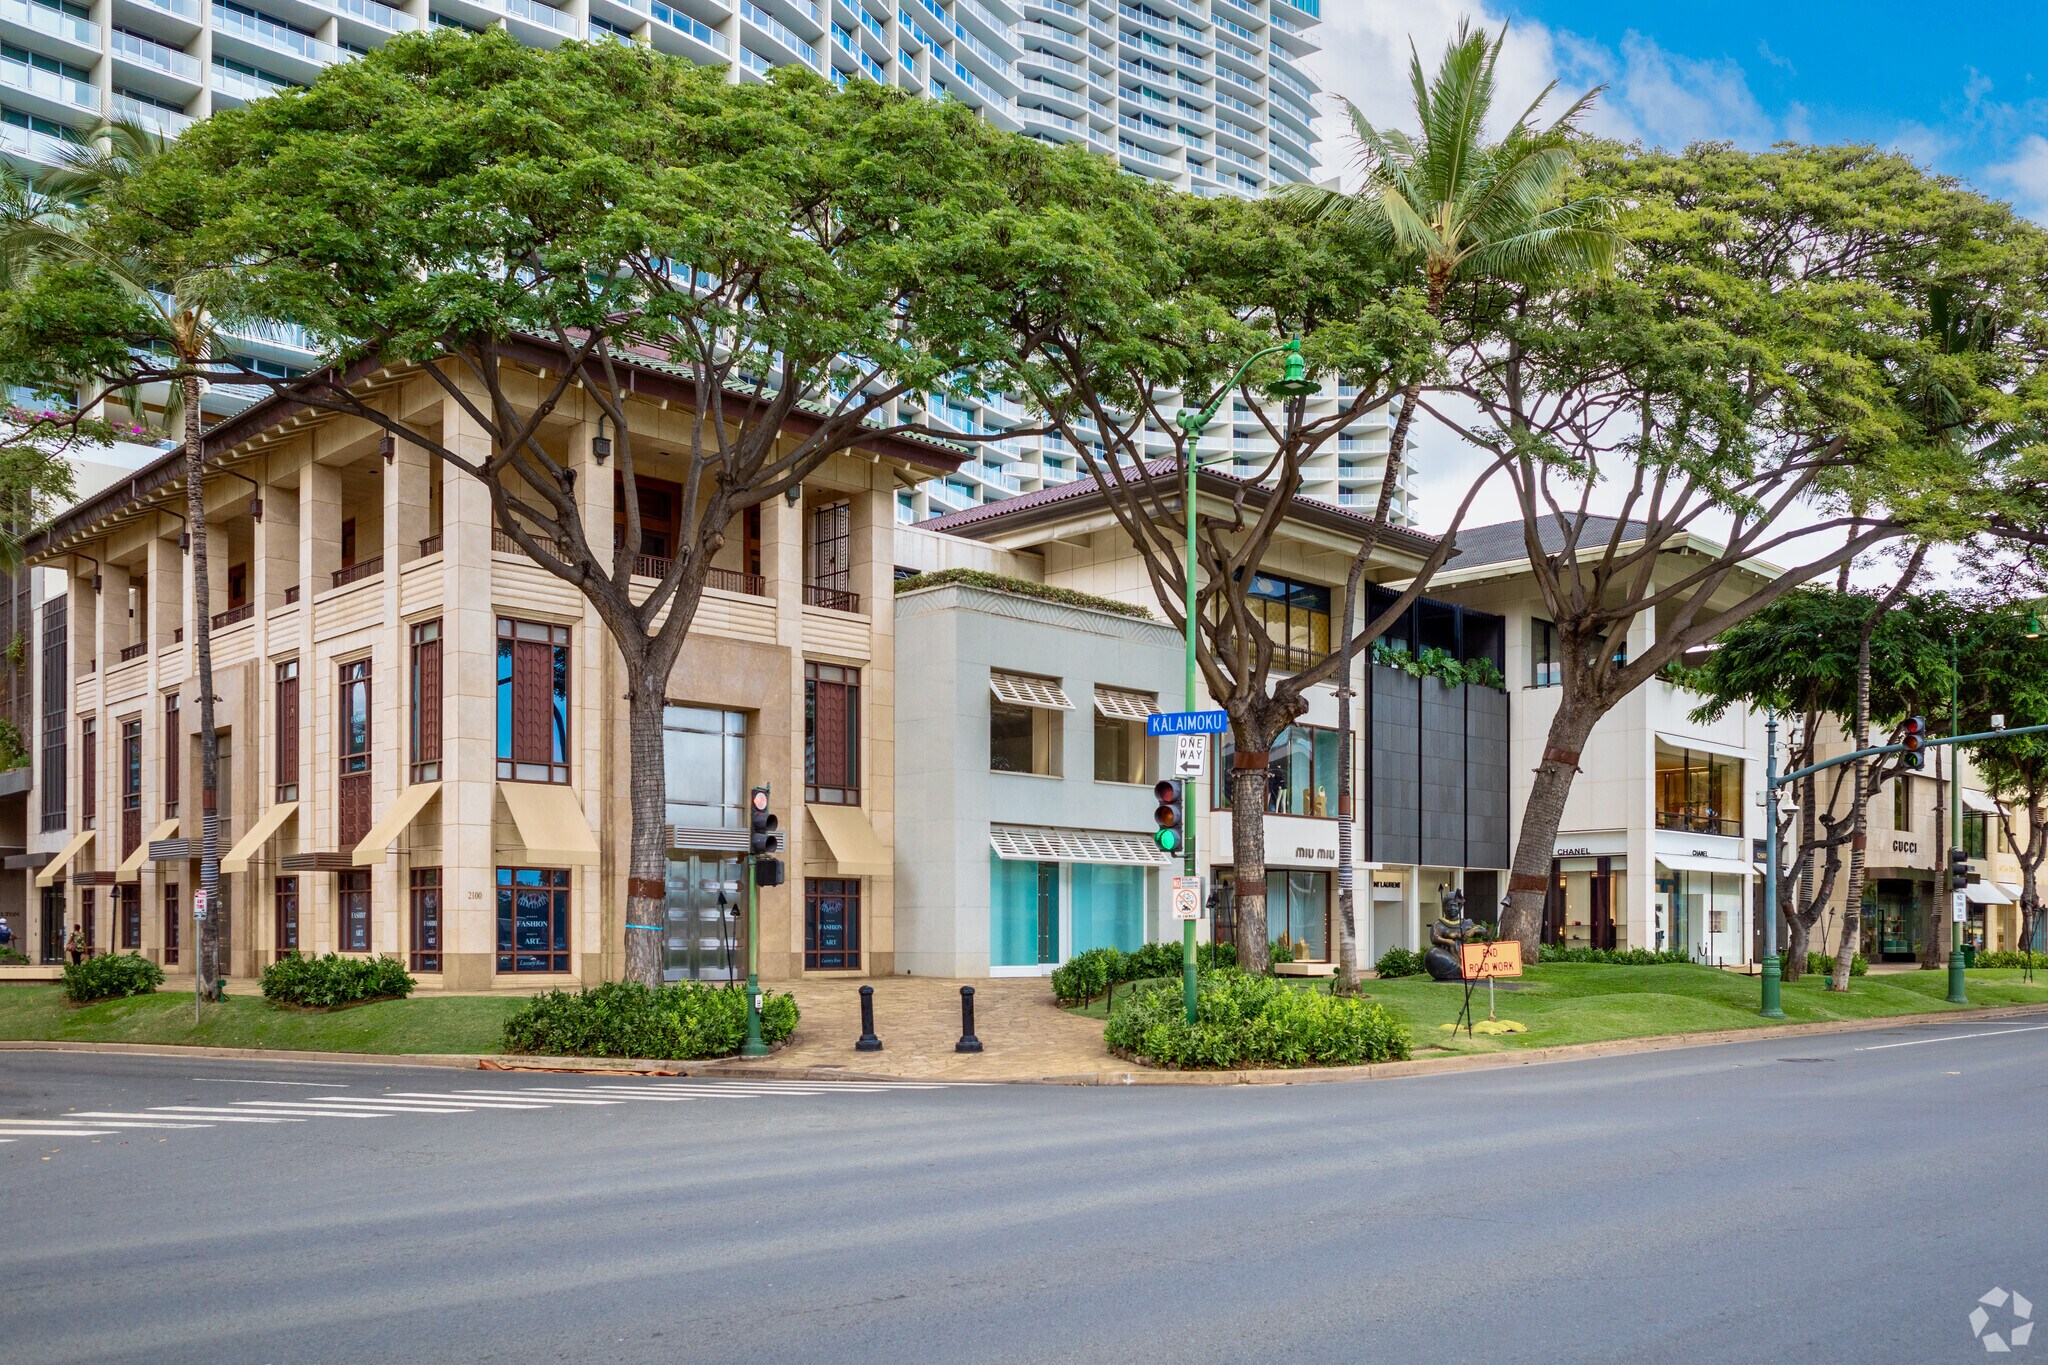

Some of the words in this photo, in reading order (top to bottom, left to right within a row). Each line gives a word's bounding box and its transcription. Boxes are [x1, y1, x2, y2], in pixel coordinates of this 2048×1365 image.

[1152, 714, 1222, 732] KĀLAIMOKU
[1181, 737, 1203, 748] ONE
[1180, 750, 1202, 759] WAY
[1893, 840, 1917, 853] GUCCI
[1296, 847, 1314, 858] MIU
[1317, 848, 1335, 859] MIU
[1482, 948, 1498, 957] END
[1469, 963, 1489, 972] ROAD
[1492, 962, 1514, 971] WORK
